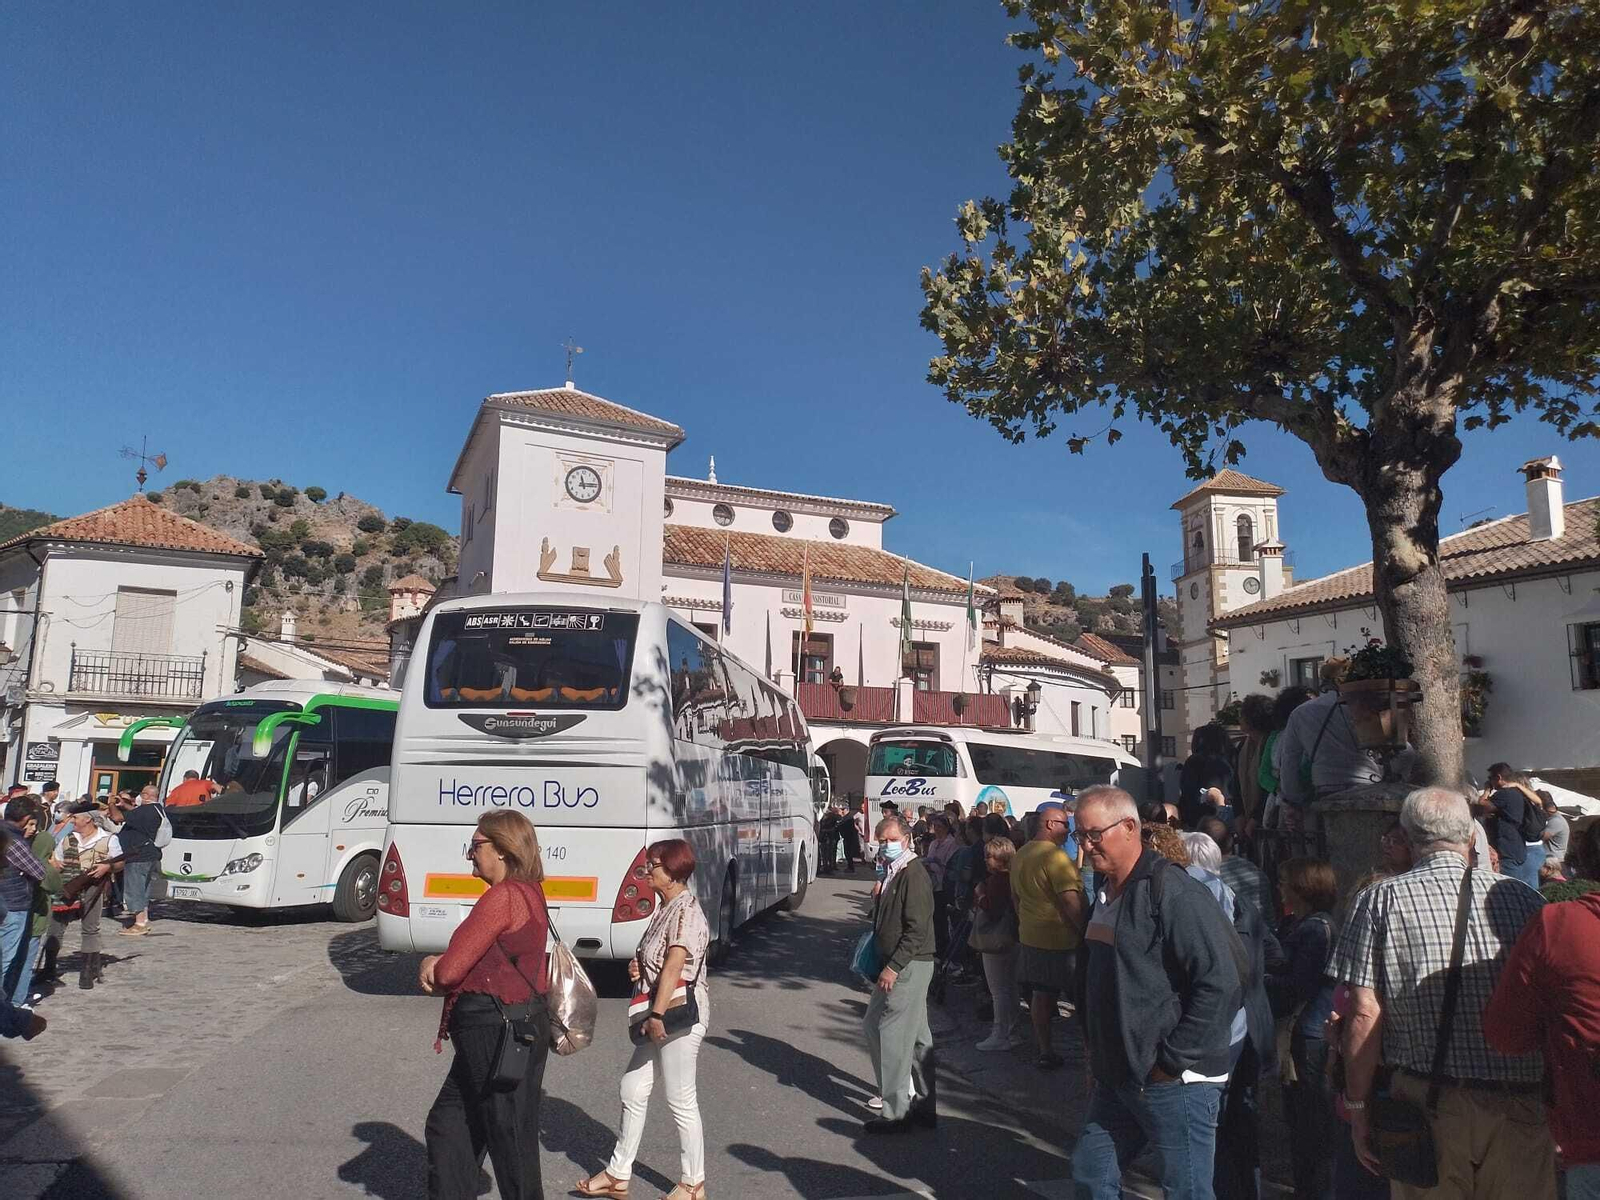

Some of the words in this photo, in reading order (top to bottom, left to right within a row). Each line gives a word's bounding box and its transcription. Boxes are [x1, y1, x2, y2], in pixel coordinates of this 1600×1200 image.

[466, 617, 481, 627] ABS
[483, 617, 498, 625] ASR
[484, 717, 557, 732] Sunsundegui
[439, 778, 535, 808] Herrera
[543, 780, 599, 808] Bus
[880, 778, 938, 796] LeoBus
[341, 796, 389, 823] Premiu
[546, 846, 567, 860] 140
